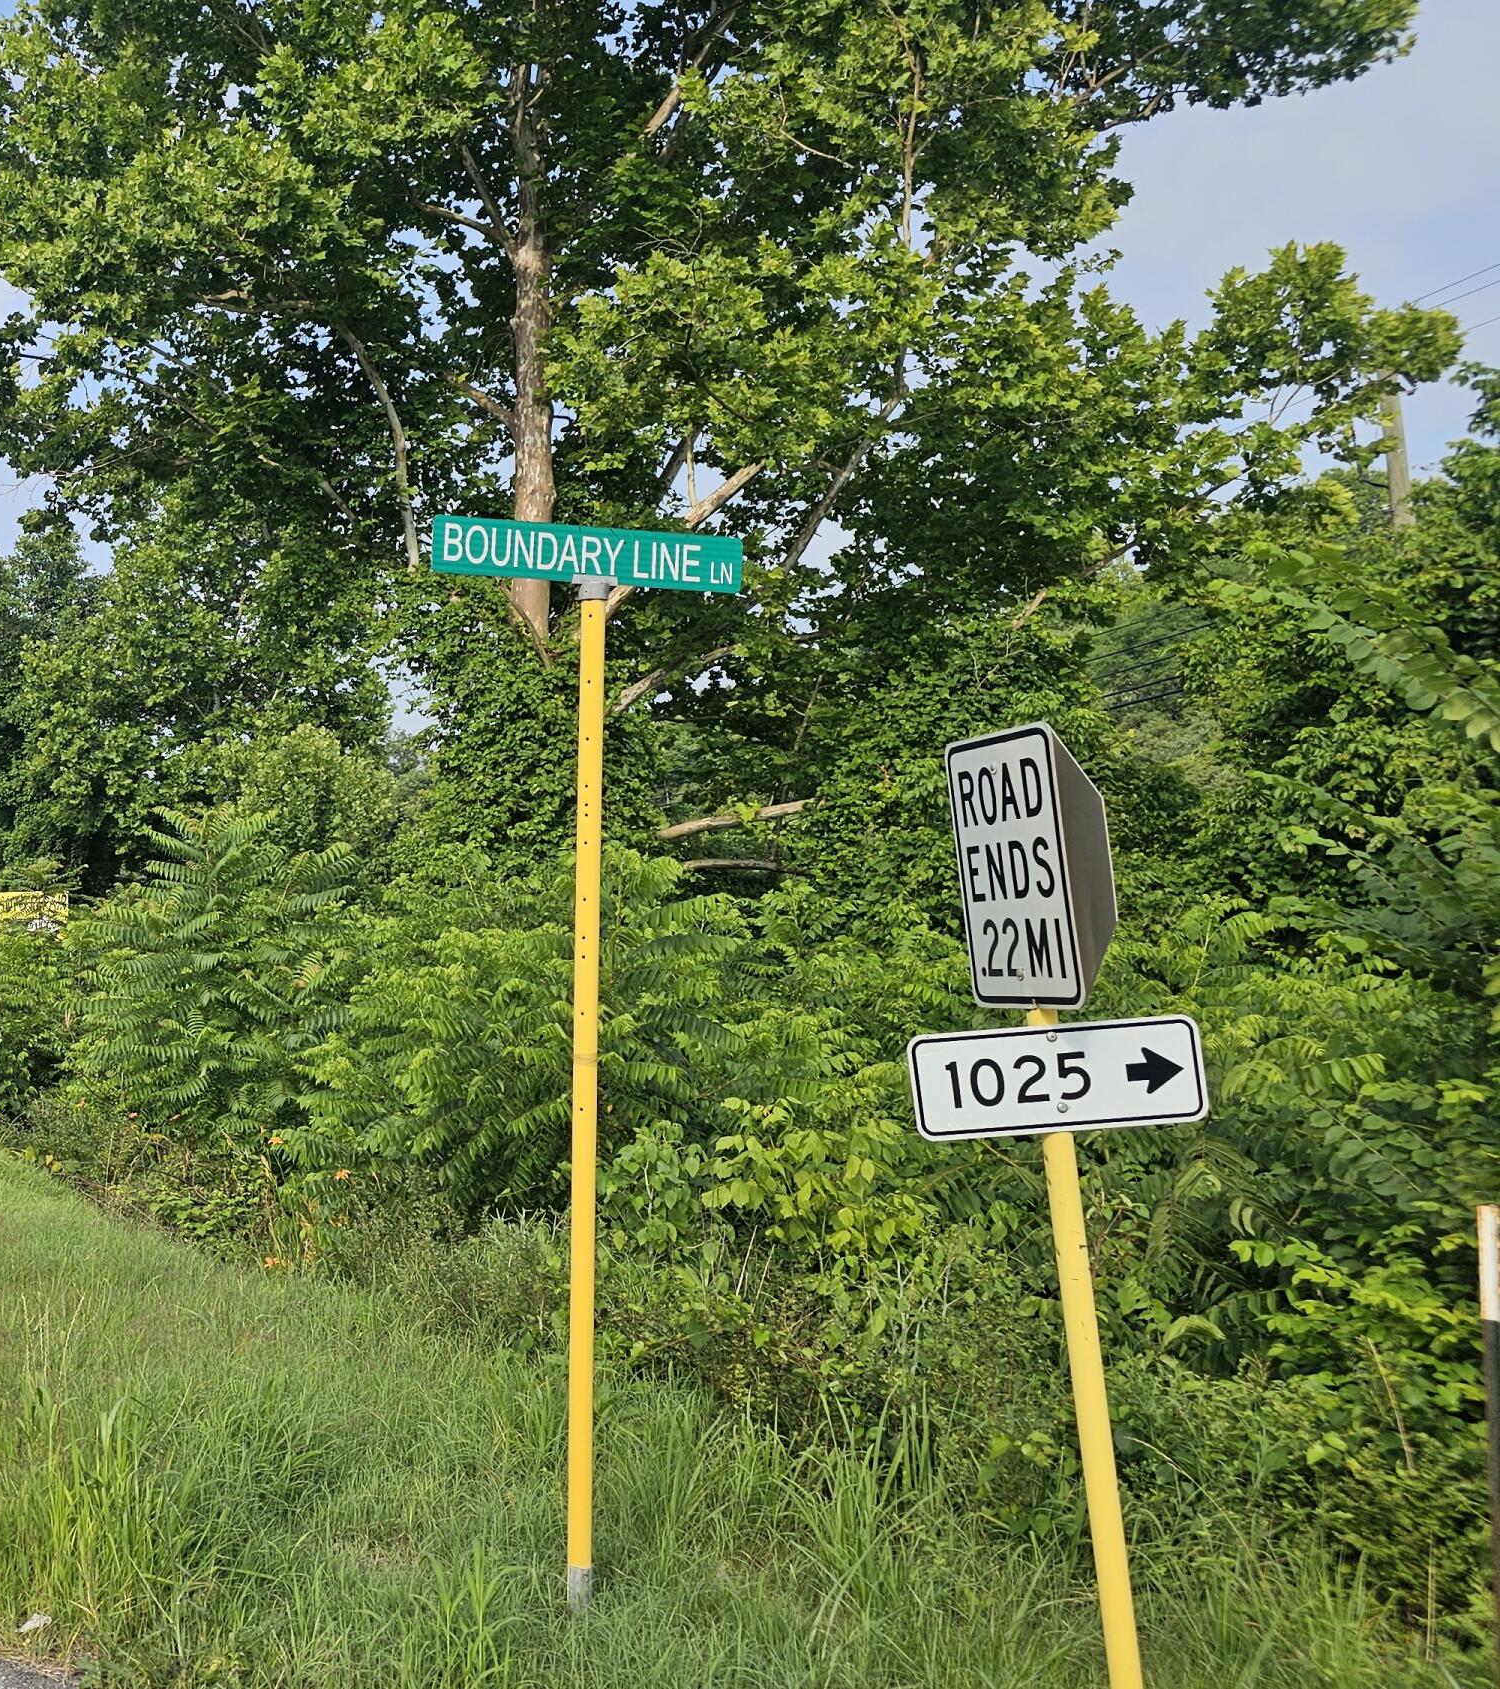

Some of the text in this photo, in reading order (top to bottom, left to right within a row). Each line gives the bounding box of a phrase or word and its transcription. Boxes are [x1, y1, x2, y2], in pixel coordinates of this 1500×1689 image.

[443, 522, 733, 585] BOUNDARY LINE LN
[957, 757, 1043, 828] ROAD
[966, 836, 1055, 903] ENDS
[945, 1051, 1092, 1109] 1025
